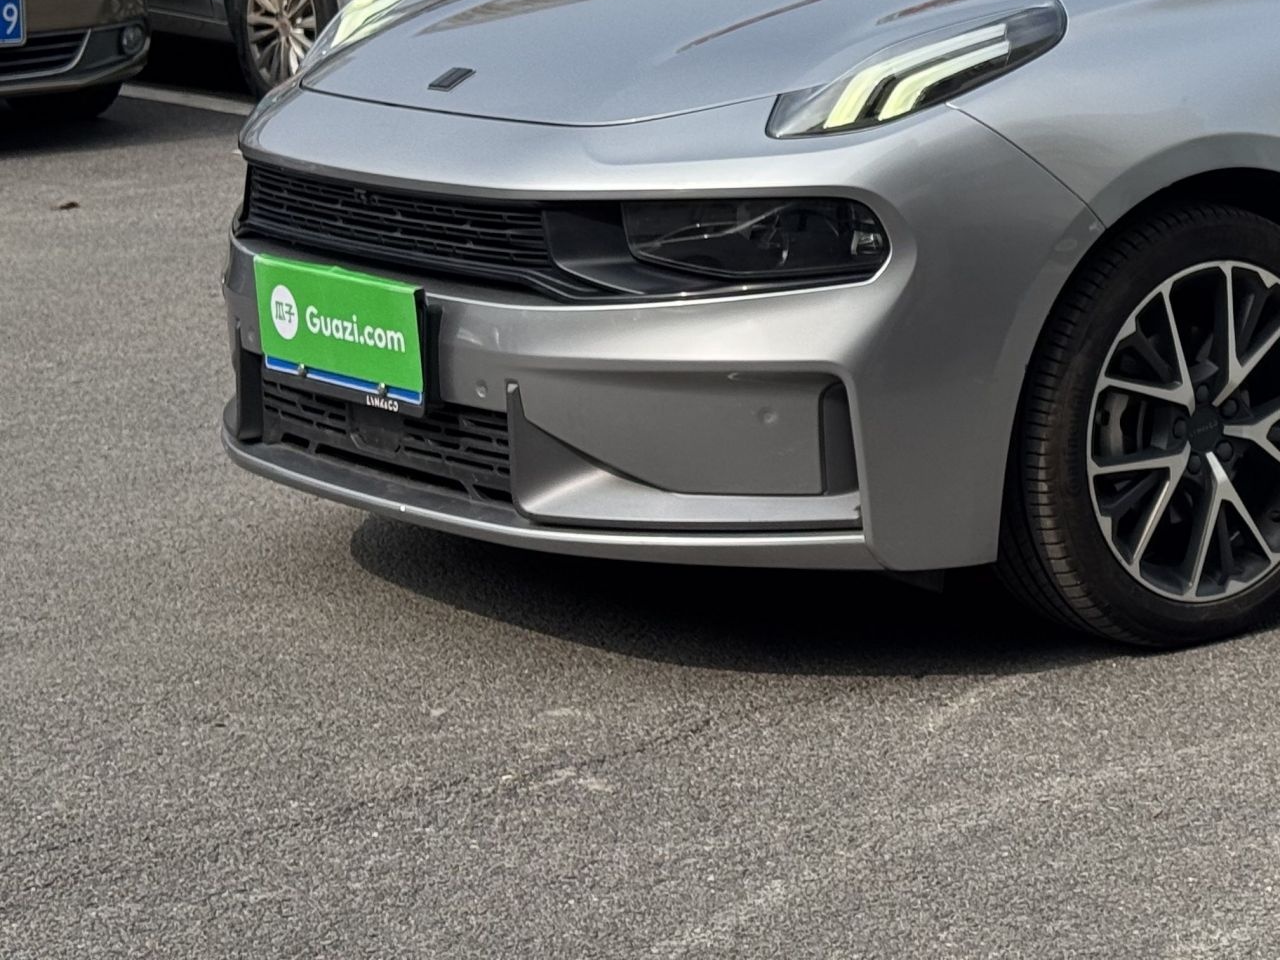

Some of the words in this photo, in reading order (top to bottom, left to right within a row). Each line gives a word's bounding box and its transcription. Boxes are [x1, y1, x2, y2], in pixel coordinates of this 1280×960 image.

[2, 3, 18, 35] 9
[274, 300, 295, 324] 瓜子
[305, 305, 406, 353] Guazi.com
